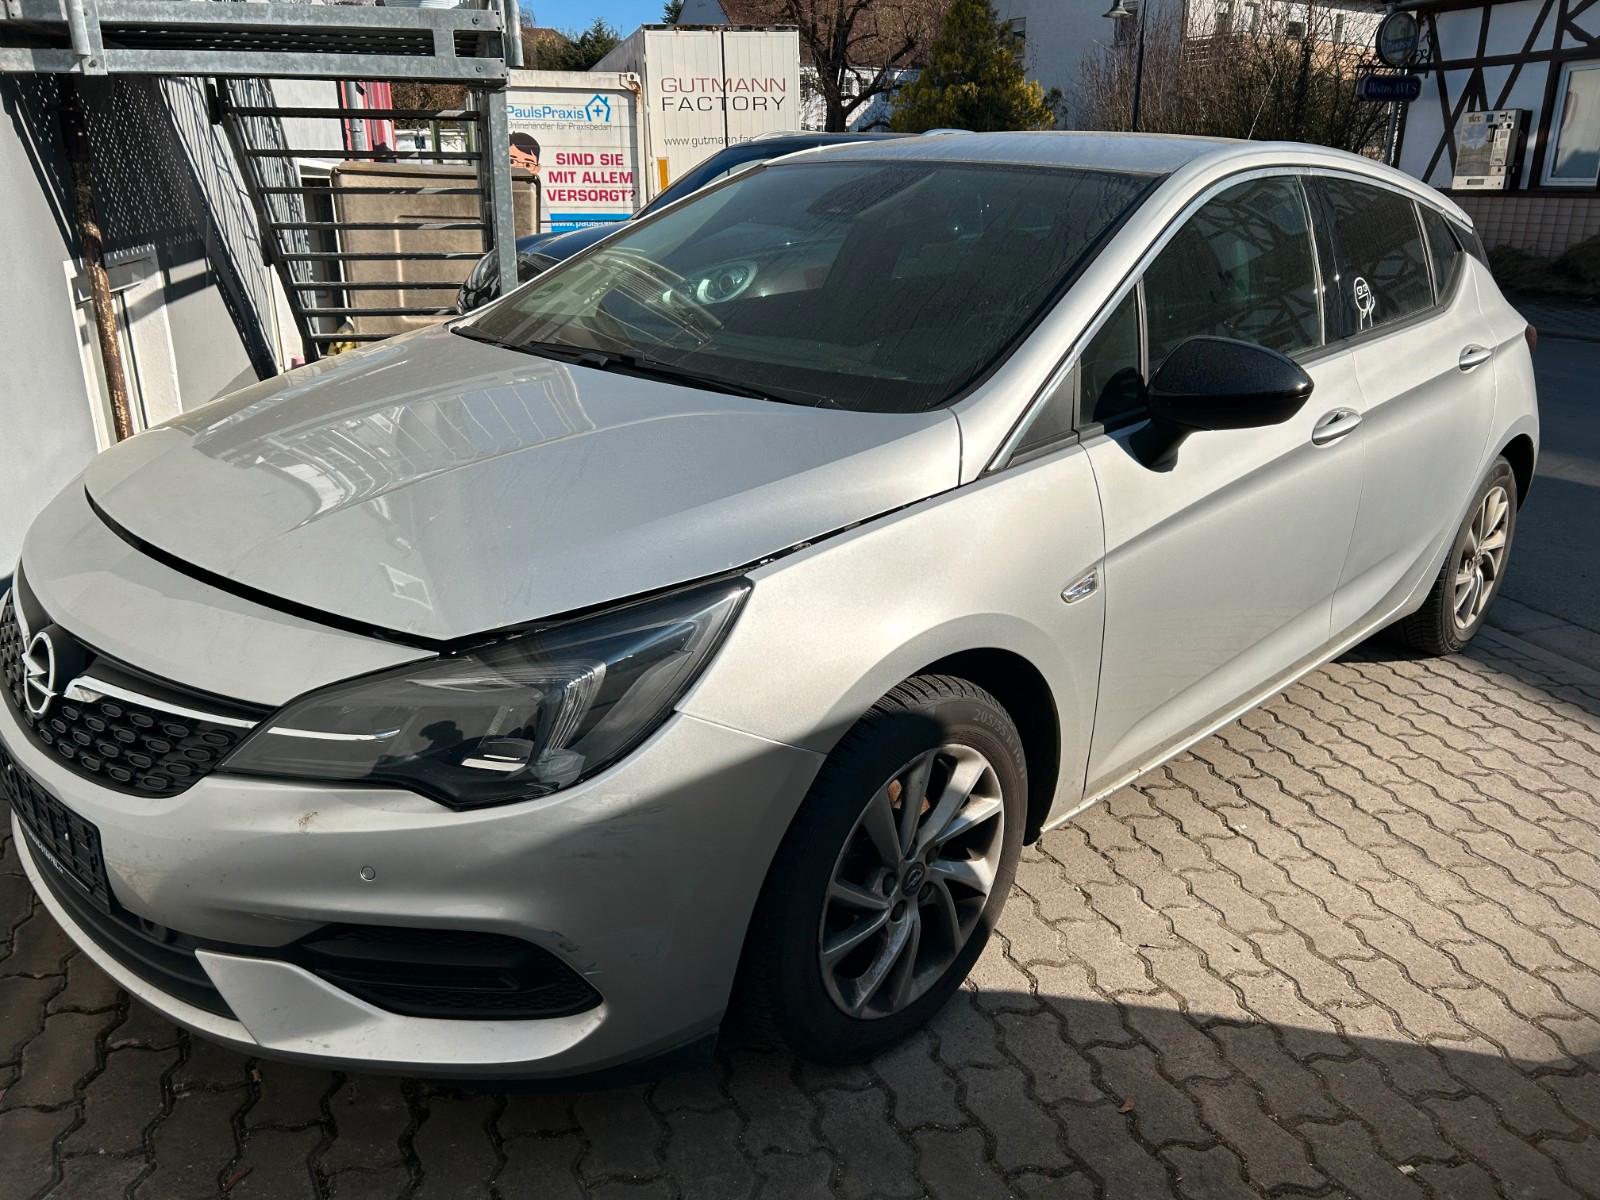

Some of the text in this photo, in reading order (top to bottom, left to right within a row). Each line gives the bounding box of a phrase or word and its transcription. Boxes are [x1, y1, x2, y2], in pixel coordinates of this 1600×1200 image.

[661, 77, 786, 93] GUTMANN
[662, 96, 786, 111] FACTORY
[507, 105, 584, 119] PaulsPraxis
[556, 153, 624, 166] SIND SIE
[548, 171, 633, 184] MIT ALLEM
[546, 189, 636, 202] VERSORGT?
